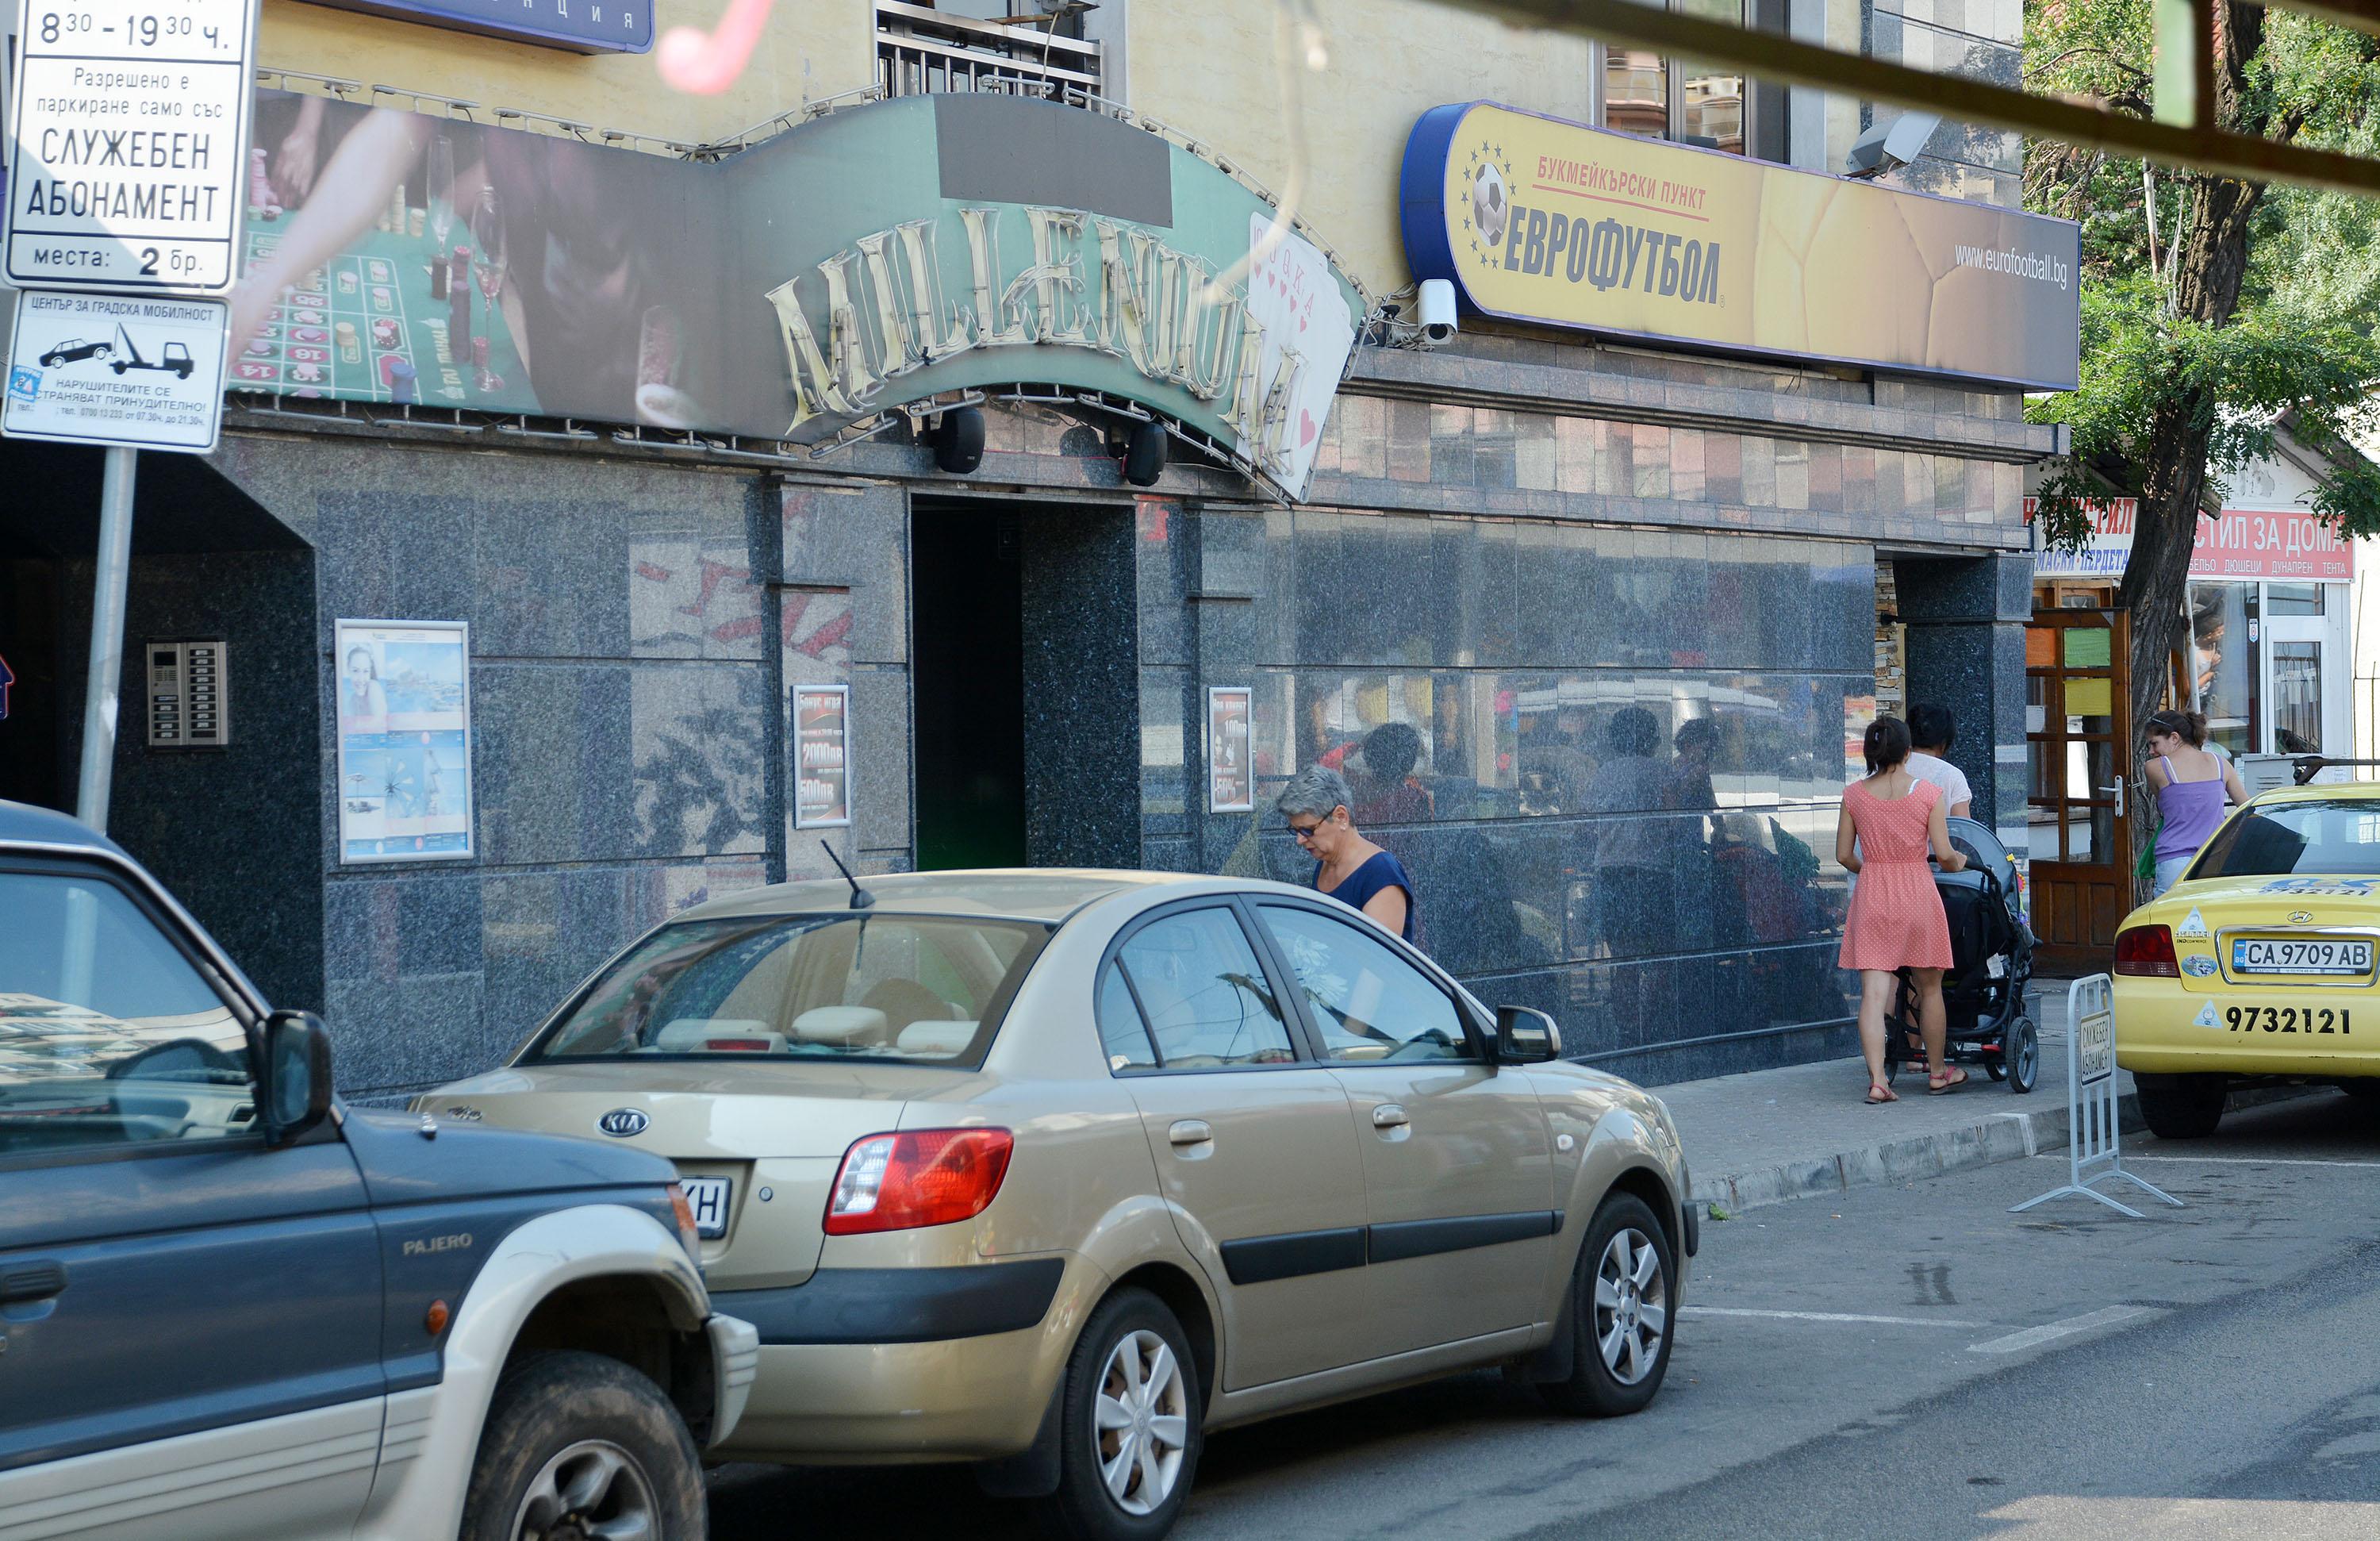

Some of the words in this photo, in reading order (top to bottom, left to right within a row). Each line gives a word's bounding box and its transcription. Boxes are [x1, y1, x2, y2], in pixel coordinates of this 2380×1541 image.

[490, 0, 633, 29] НЦИЯ
[203, 25, 228, 49] ч.
[74, 67, 170, 91] Разрешено
[181, 75, 189, 90] е
[36, 97, 129, 117] паркиране
[140, 100, 182, 117] само
[193, 102, 223, 118] със
[41, 128, 210, 170] СЛУЖЕБЕН
[1537, 156, 1656, 200] БУКМЕЙКЪРСКИ
[1660, 181, 1706, 210] ПУНКТ
[26, 179, 219, 222] АБОНАМЕНТ
[33, 248, 111, 268] места:
[139, 247, 159, 276] 2
[170, 249, 203, 276] бр.
[1503, 205, 1721, 305] ЕВРОФУТБОЛ
[1955, 244, 2067, 290] www.eurofootball.bg
[1292, 264, 1304, 296] K
[1303, 292, 1315, 318] A
[31, 297, 72, 310] ЦЕНТЪР
[75, 300, 89, 312] ЗА
[92, 301, 140, 316] ГРАДСКА
[143, 305, 214, 321] МОБИЛНОСТ
[56, 379, 151, 395] НАРУШИТЕЛИТЕ
[155, 386, 171, 397] СЕ
[105, 395, 206, 412] ПРИНУДИТЕЛНО!
[2253, 517, 2281, 551] ЗА
[2286, 516, 2347, 559] ДОМА
[2224, 559, 2262, 575] ДЮШЕЦИ
[2271, 560, 2313, 575] ДУНАПРЕН
[2322, 562, 2346, 575] ТЕНТА
[2248, 944, 2278, 965] CA
[2281, 944, 2334, 966] 9709
[2338, 945, 2367, 966] AB
[2226, 1006, 2351, 1036] 9732121
[605, 1114, 639, 1132] KIA
[403, 1232, 474, 1255] PAJERO
